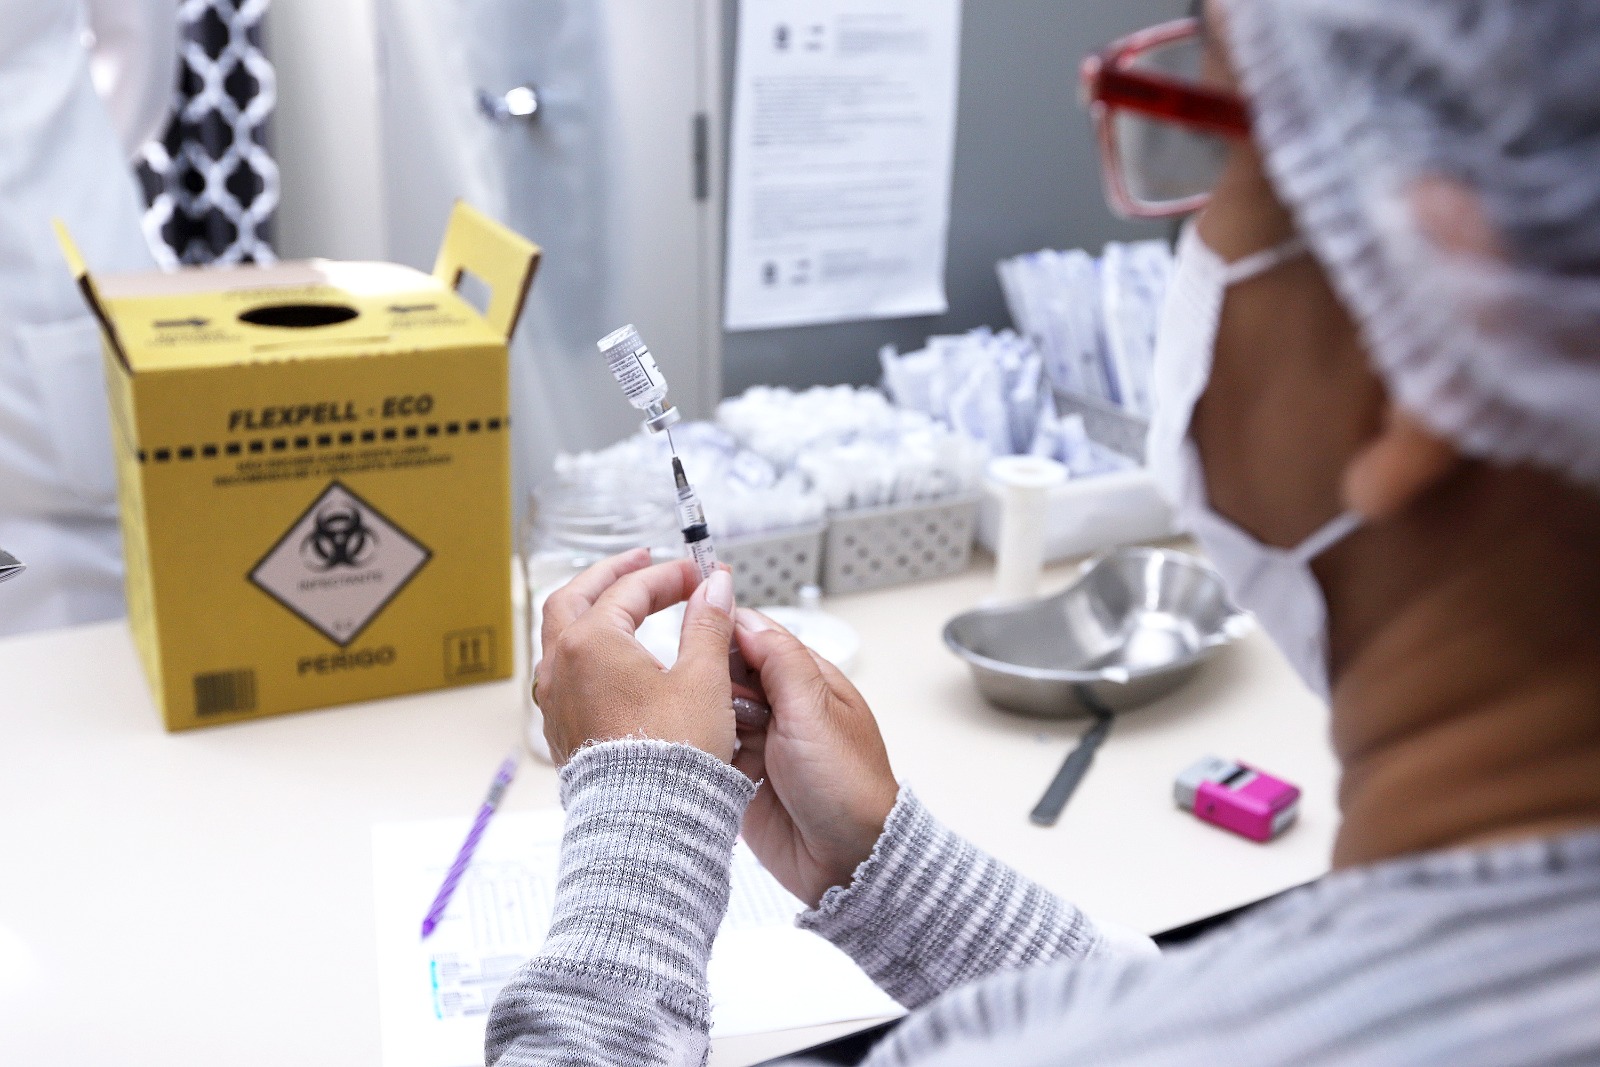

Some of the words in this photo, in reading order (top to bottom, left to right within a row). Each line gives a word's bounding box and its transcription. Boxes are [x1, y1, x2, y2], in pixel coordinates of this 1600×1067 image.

[228, 401, 358, 431] FLEXPELL
[381, 393, 434, 419] ECO
[297, 646, 397, 676] PERIGO
